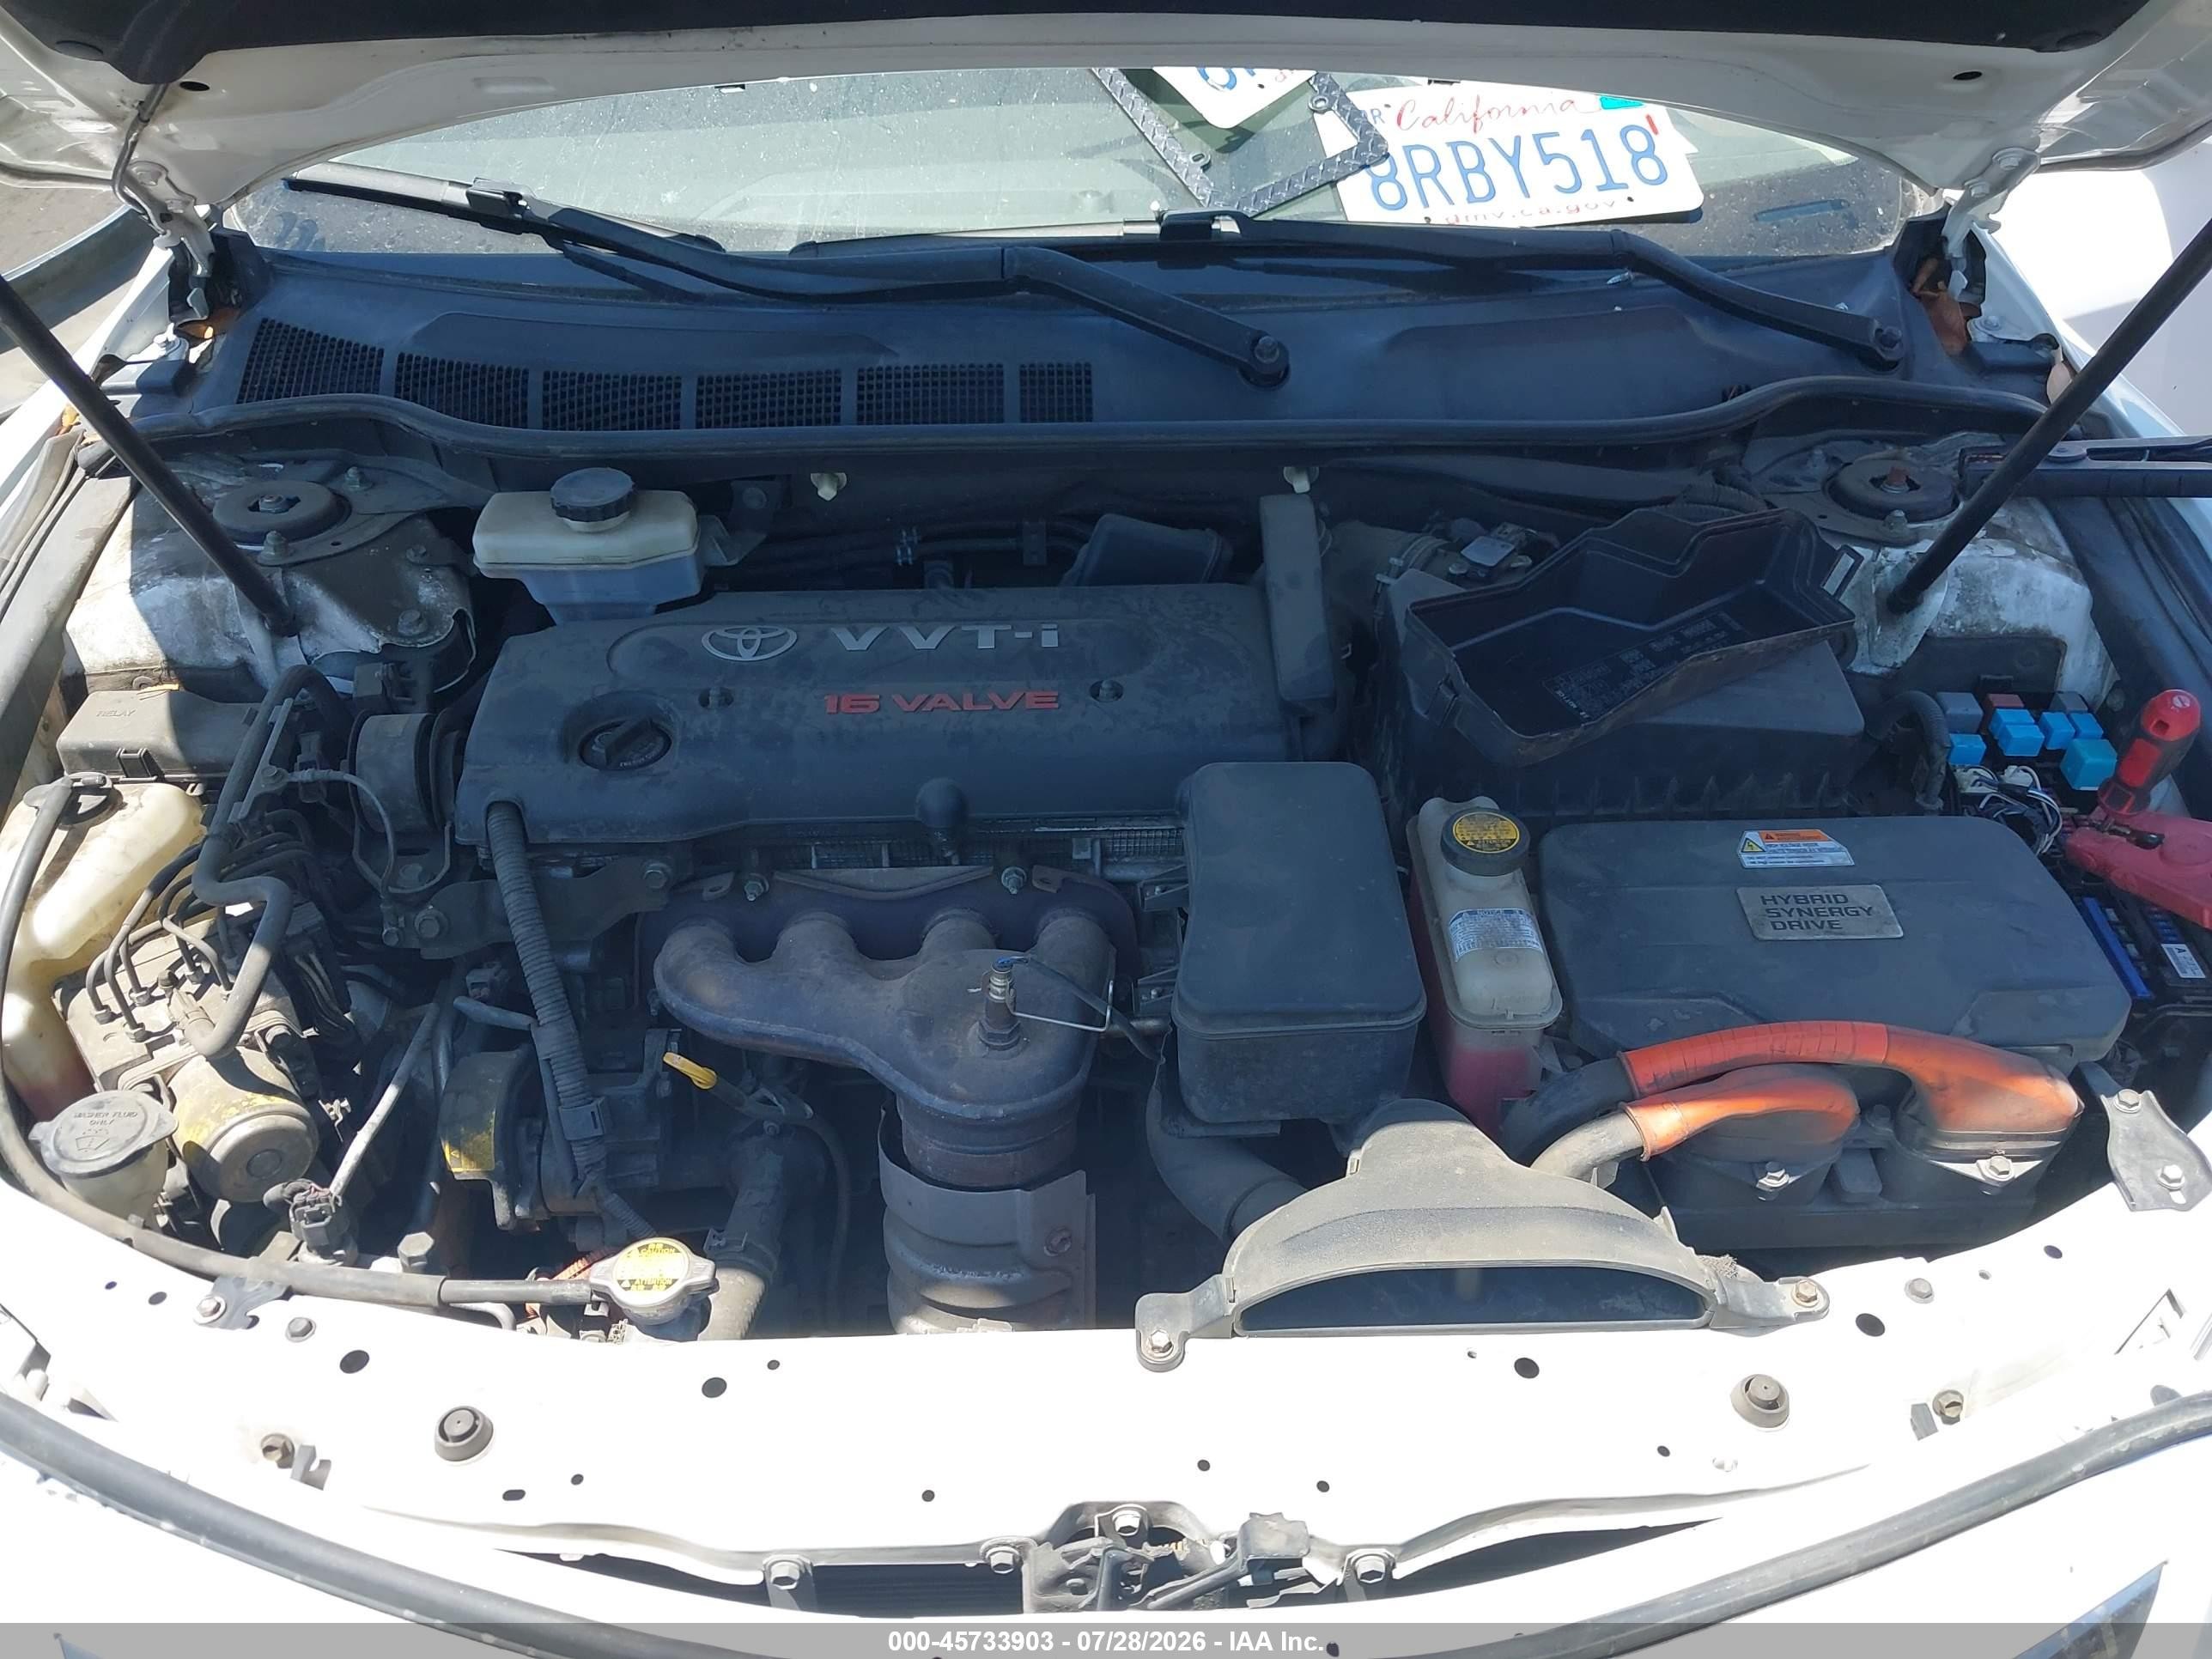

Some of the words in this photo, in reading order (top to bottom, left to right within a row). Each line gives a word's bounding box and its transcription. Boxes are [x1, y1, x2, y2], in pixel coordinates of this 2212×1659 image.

[1396, 95, 1589, 134] California
[1363, 125, 1668, 211] 8RBY518
[1445, 200, 1615, 225] dmv.ca.gov
[830, 624, 1059, 651] VVT-i
[96, 708, 137, 717] RELAY
[824, 694, 880, 714] 16
[891, 691, 1059, 712] VALVE
[1760, 894, 1849, 906] HYBRID
[1765, 906, 1873, 919] SYNERGY
[1771, 920, 1843, 931] DRIVE
